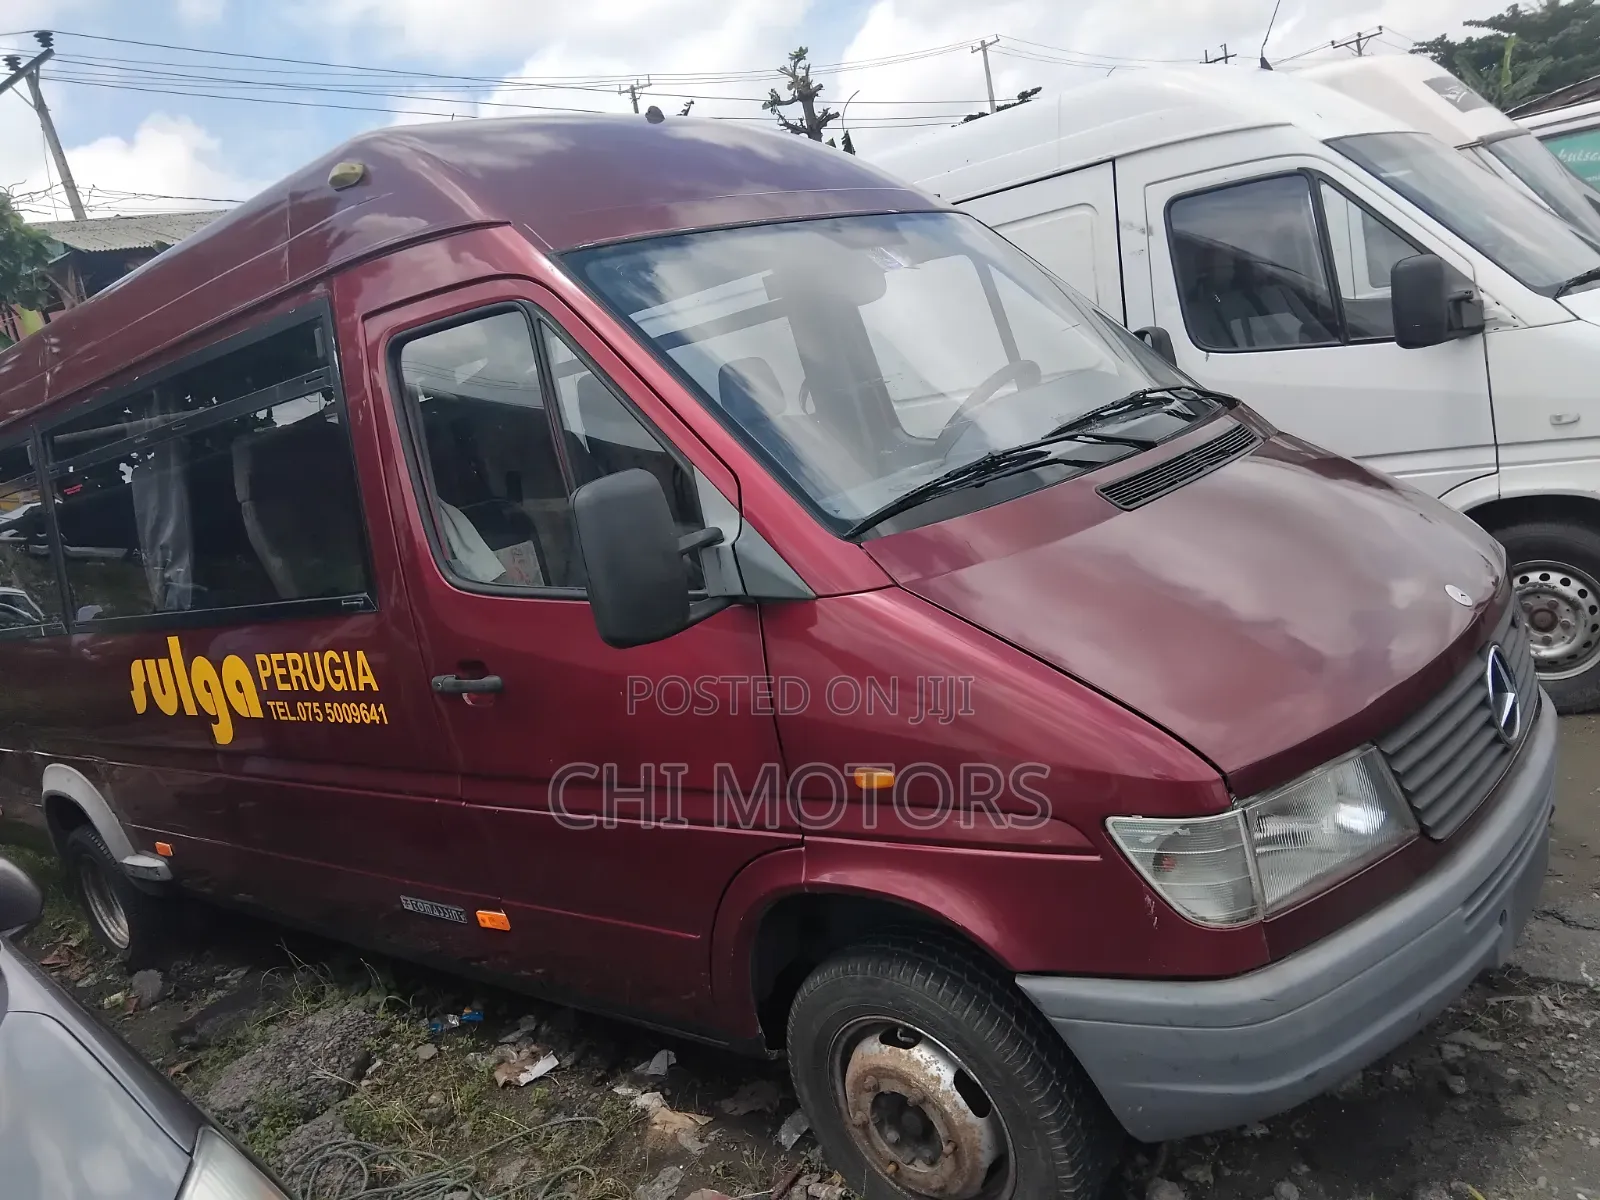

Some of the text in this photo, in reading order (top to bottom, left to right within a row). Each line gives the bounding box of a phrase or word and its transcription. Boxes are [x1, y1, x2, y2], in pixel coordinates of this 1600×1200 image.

[130, 636, 264, 745] sulga
[255, 650, 379, 692] PERUGIA
[267, 701, 388, 725] TEL.075 5009641
